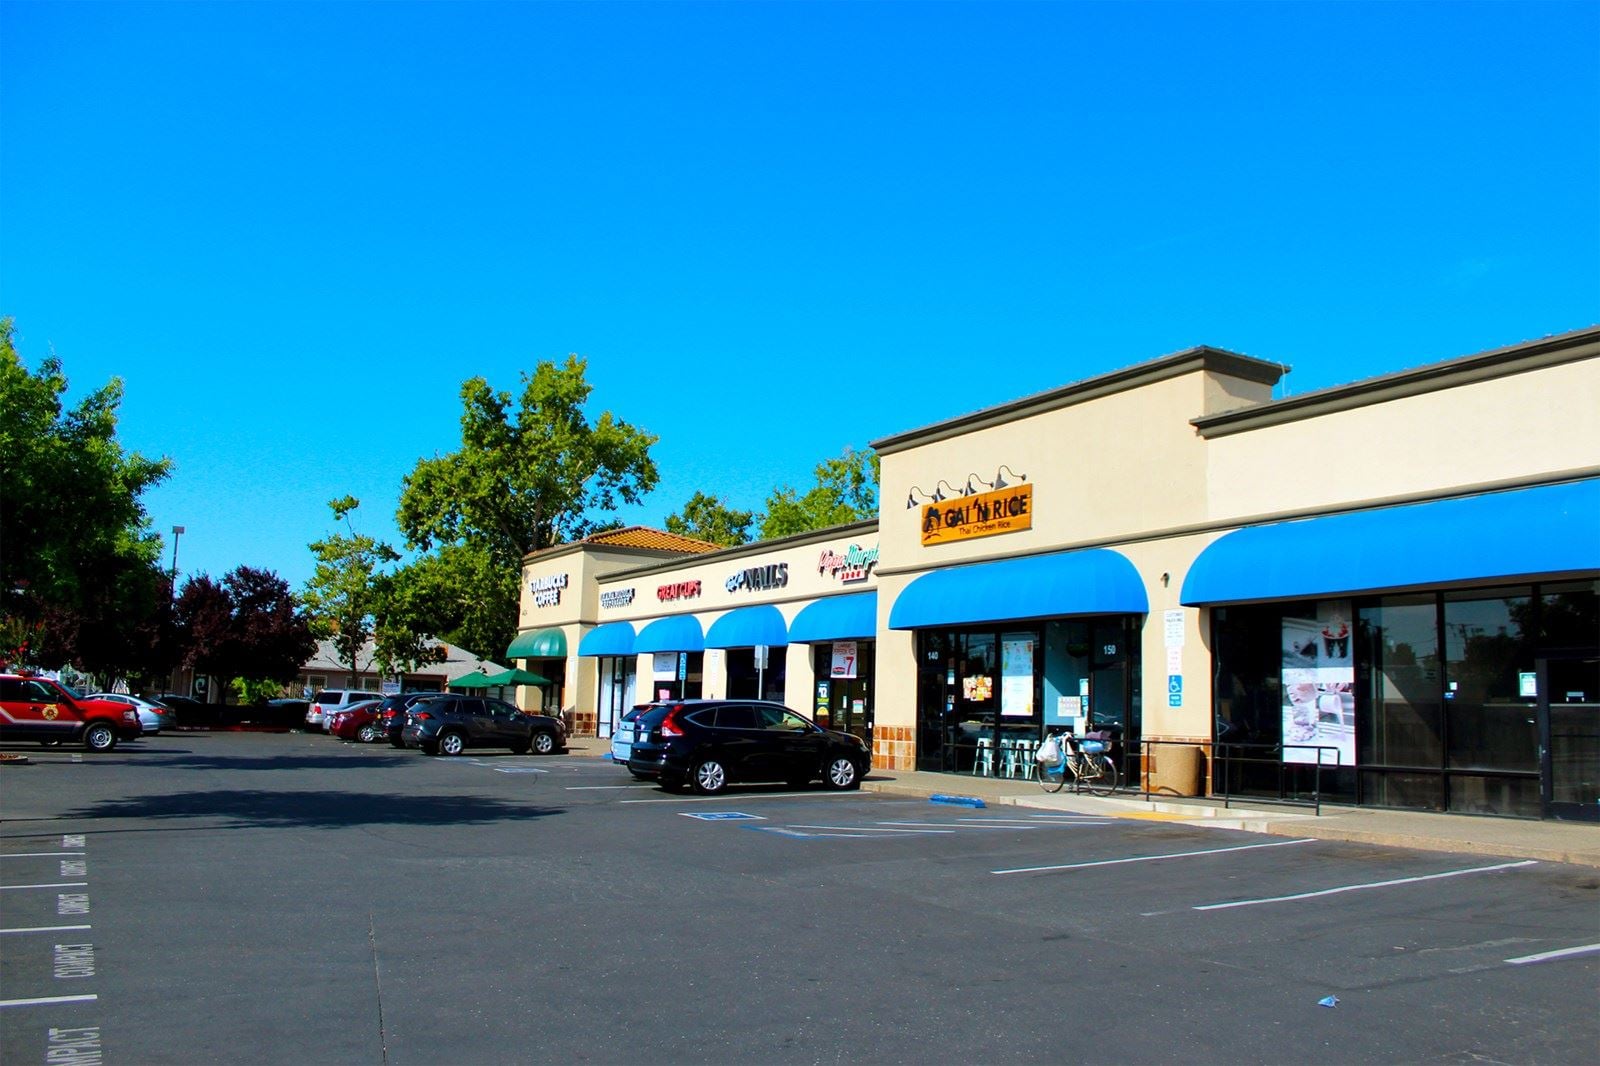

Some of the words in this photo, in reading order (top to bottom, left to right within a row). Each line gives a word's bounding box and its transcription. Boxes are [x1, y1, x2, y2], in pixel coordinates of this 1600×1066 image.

[944, 505, 970, 528] GAI
[993, 494, 1028, 518] RICE
[973, 523, 997, 534] Chicken
[997, 519, 1011, 529] Rice
[745, 563, 788, 590] NAILS
[535, 590, 560, 606] COFFEE
[657, 583, 680, 600] GREAT
[928, 651, 939, 660] 140
[1103, 644, 1117, 655] 150
[54, 943, 96, 978] COMPACT
